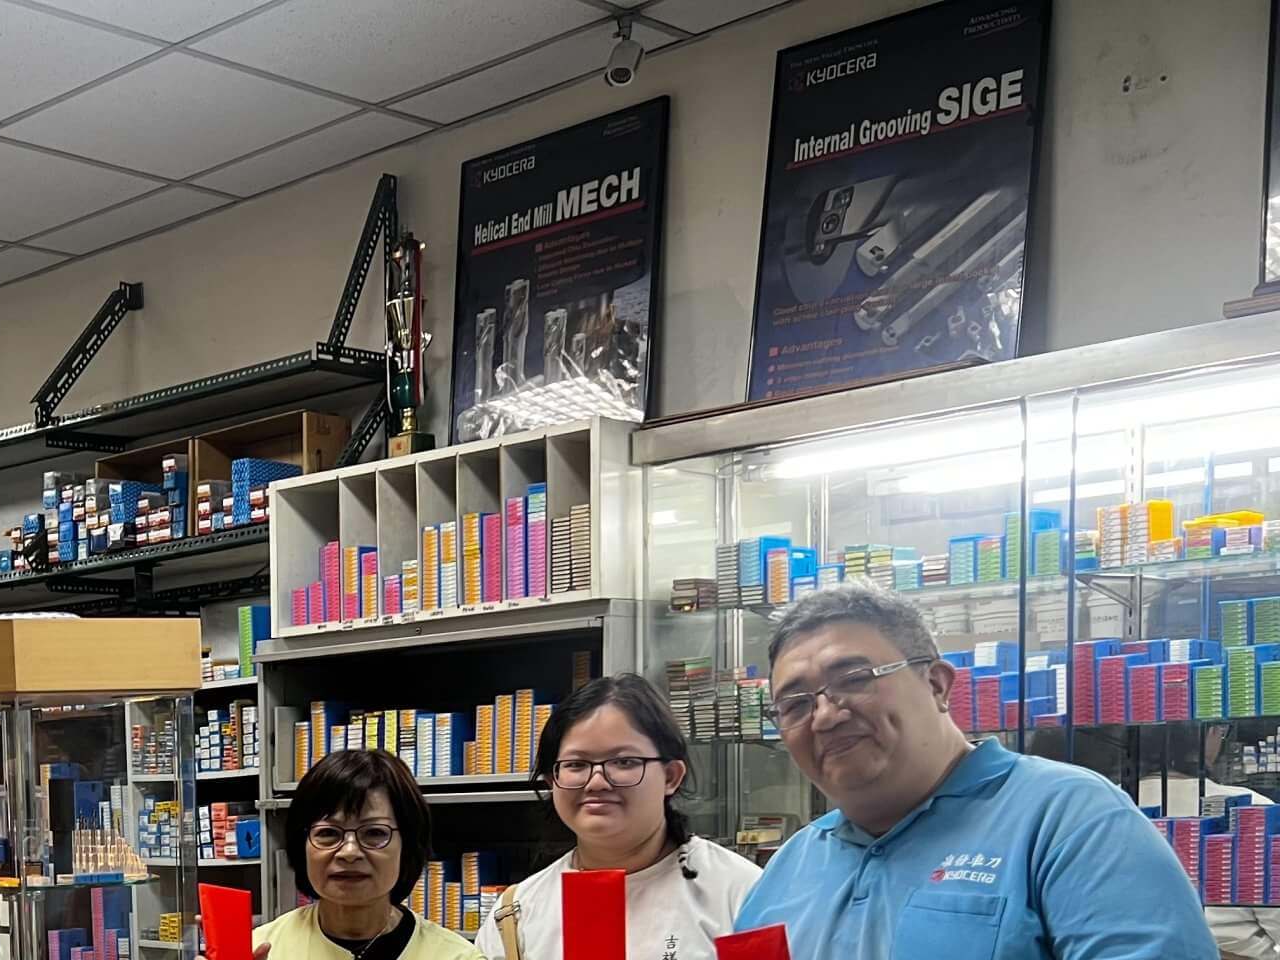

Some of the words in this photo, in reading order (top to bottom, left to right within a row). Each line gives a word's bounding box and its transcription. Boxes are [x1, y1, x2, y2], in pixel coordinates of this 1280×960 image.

[806, 52, 877, 87] KYOCERA
[794, 124, 855, 162] Internal
[859, 108, 932, 146] Grooving
[936, 69, 1024, 126] SIGE
[483, 155, 536, 184] KYOCERA
[474, 216, 508, 247] Helical
[511, 208, 531, 236] End
[533, 202, 553, 229] Mill
[555, 166, 641, 222] MECH
